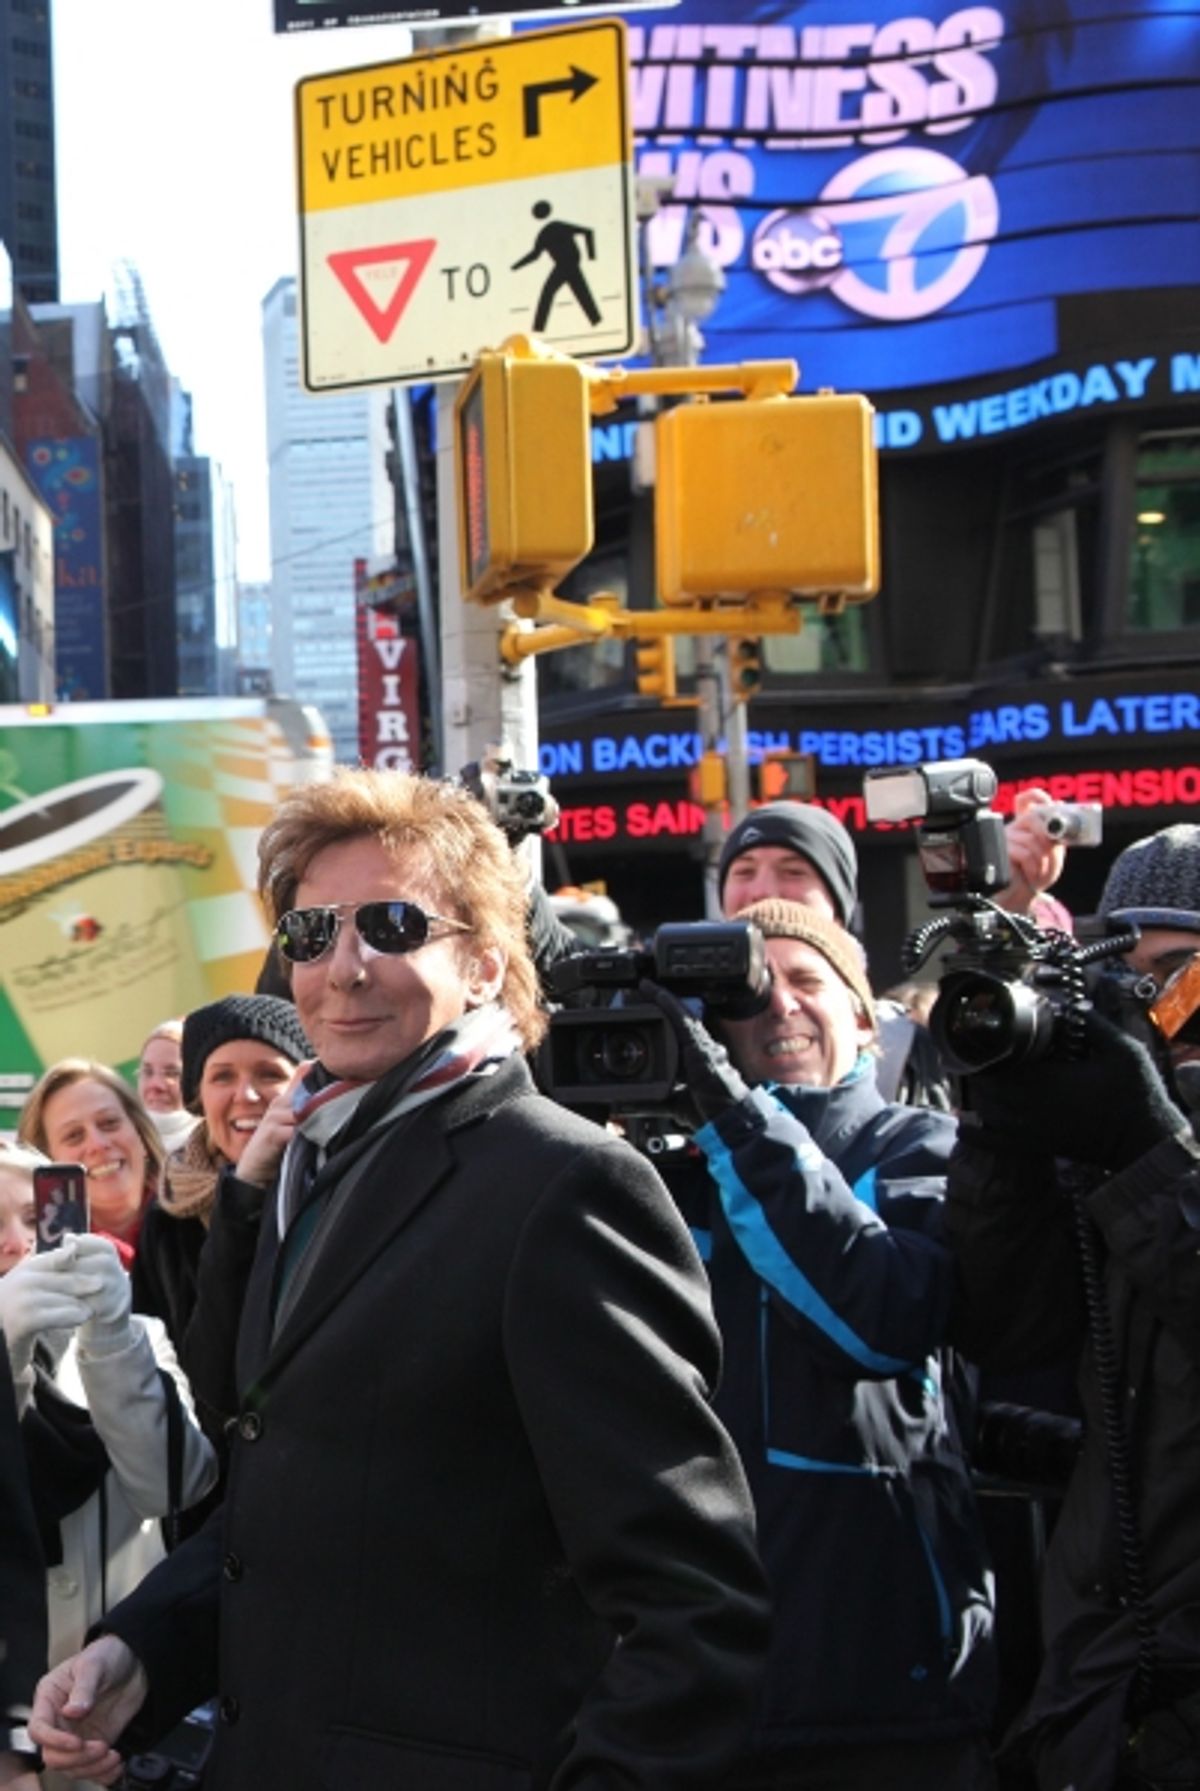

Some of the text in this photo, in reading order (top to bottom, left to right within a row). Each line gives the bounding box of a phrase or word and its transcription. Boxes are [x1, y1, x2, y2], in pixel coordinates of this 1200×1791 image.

[317, 65, 499, 129] TURNING
[322, 123, 498, 182] VEHICLES
[753, 226, 843, 271] abc
[440, 262, 491, 301] TO
[932, 358, 1156, 442] WEEKDAY
[1061, 692, 1200, 736] LATER
[799, 725, 965, 766] PERSISTS
